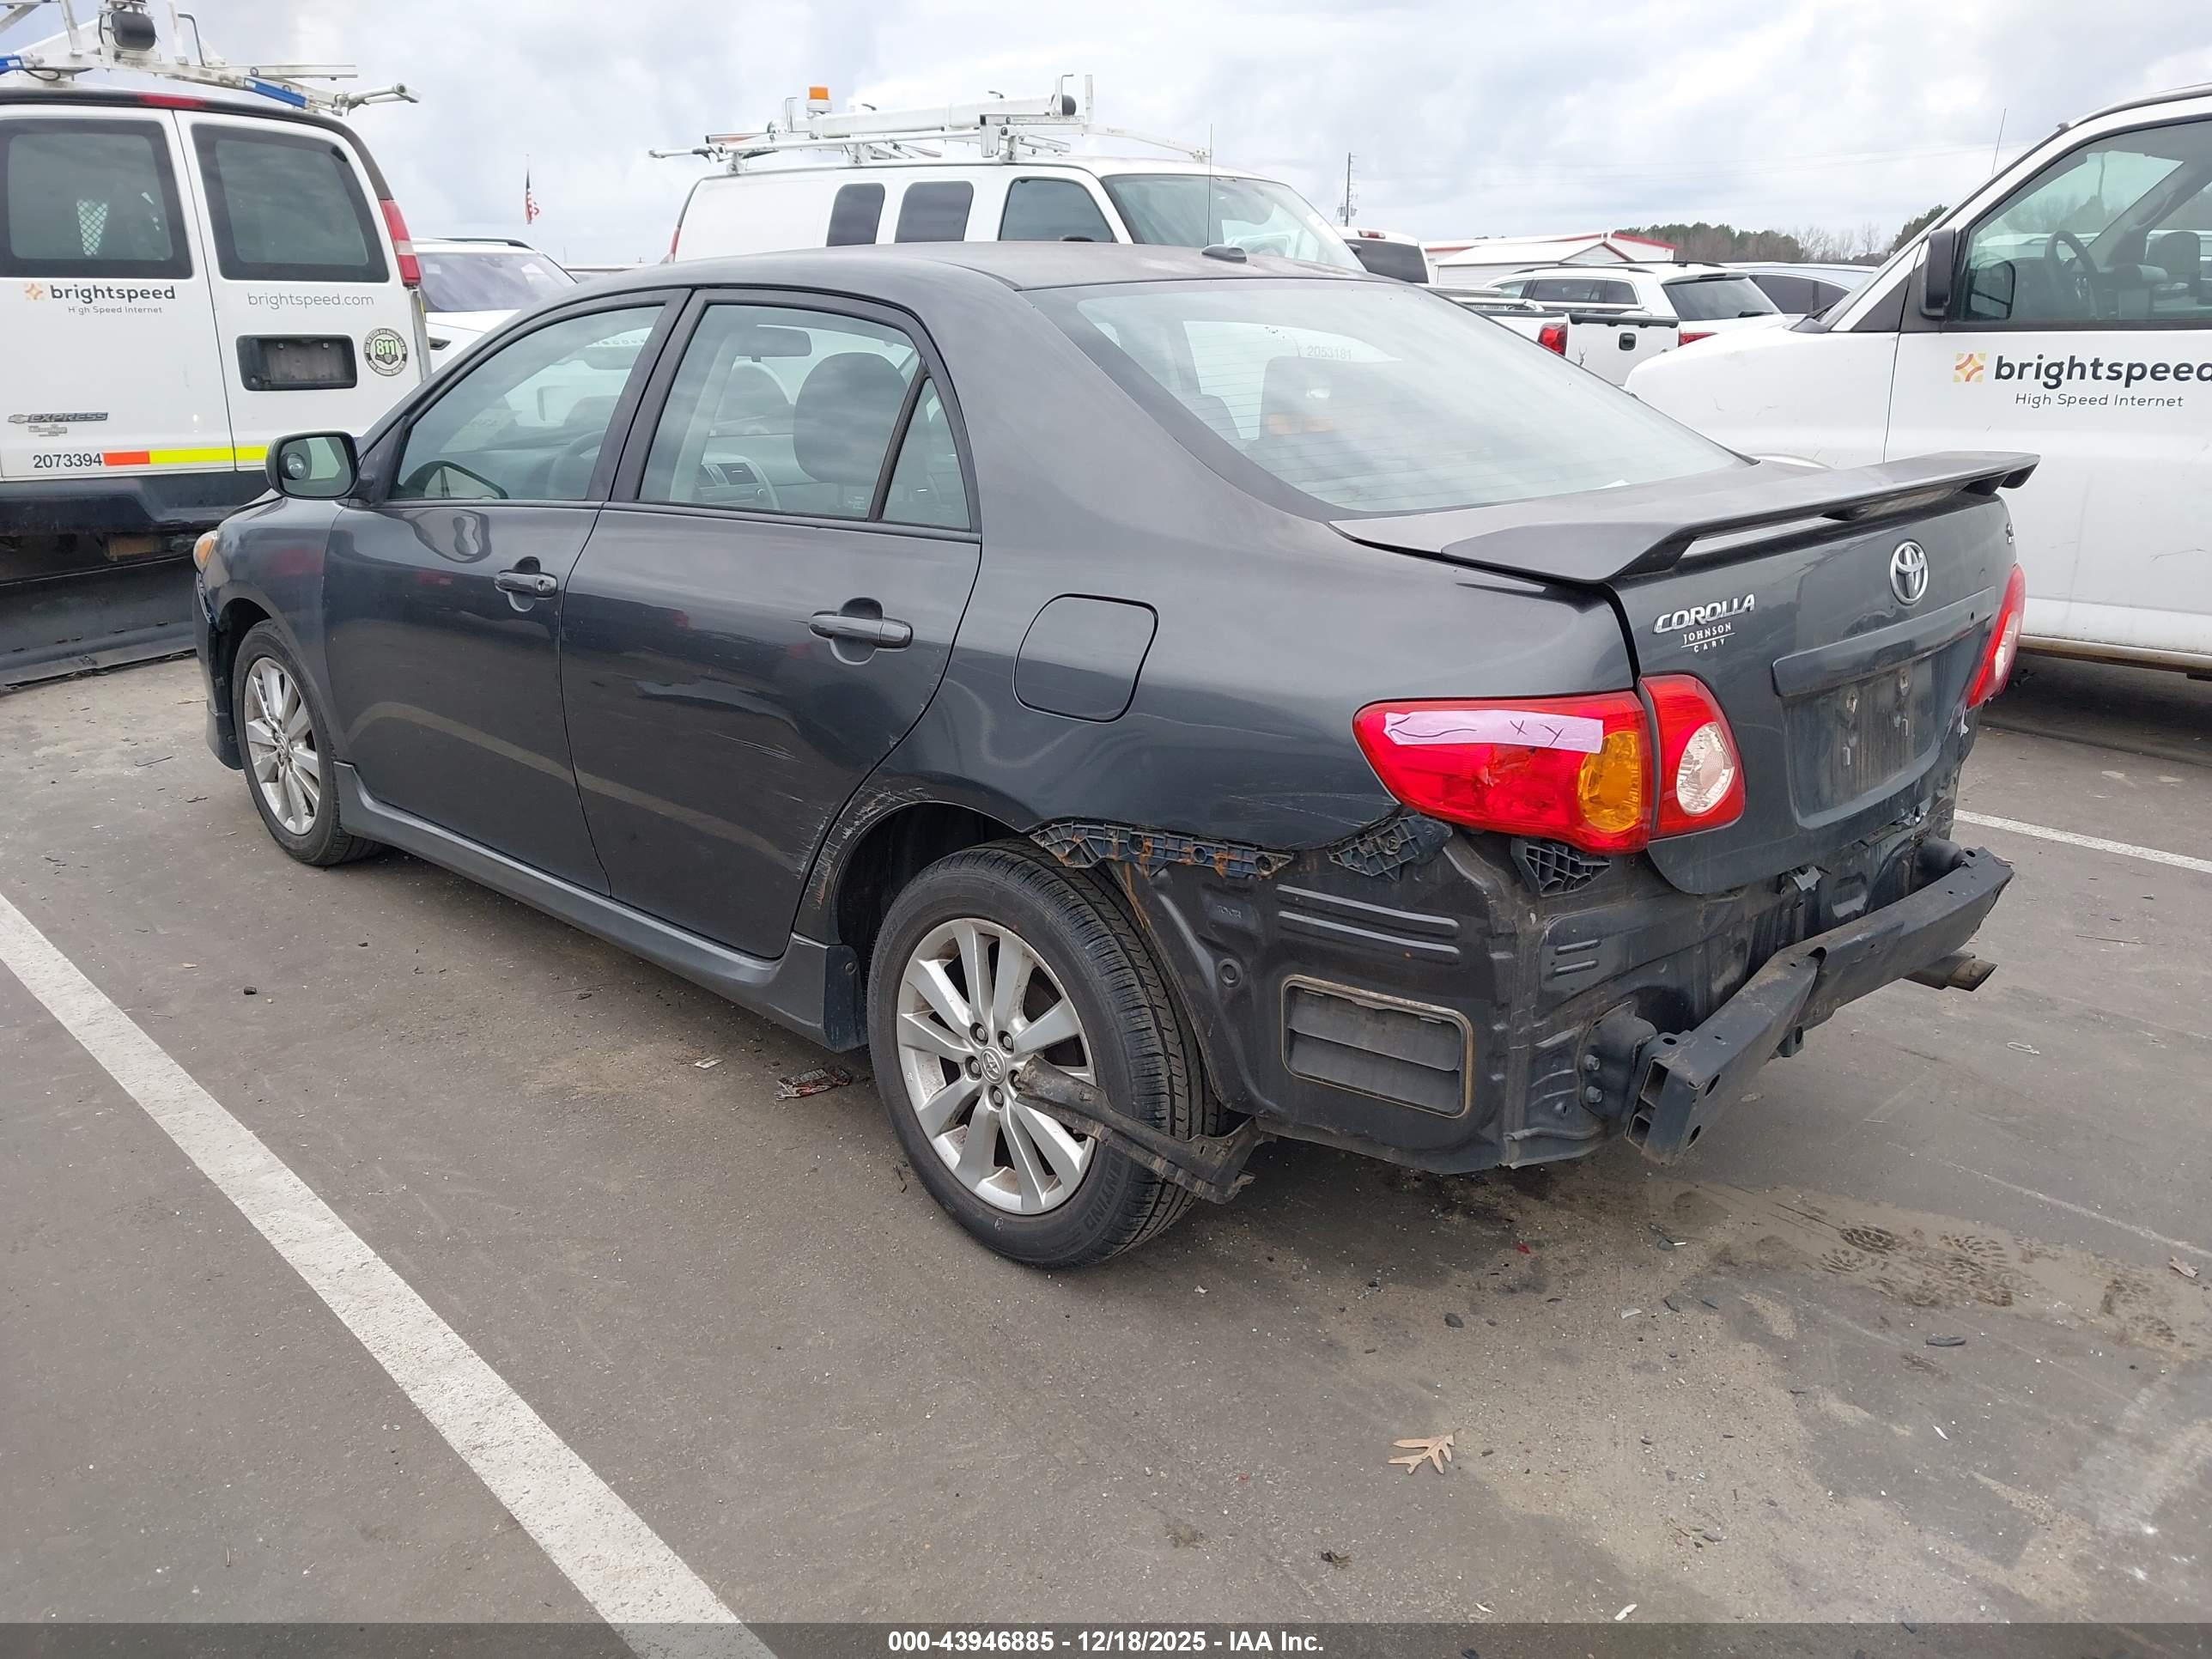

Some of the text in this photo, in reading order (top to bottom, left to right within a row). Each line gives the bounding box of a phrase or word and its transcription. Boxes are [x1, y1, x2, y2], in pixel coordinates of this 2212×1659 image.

[50, 284, 176, 304] brightspeed
[247, 292, 374, 310] brightspeed.com
[93, 306, 122, 315] Speed
[376, 339, 395, 355] 811
[2015, 392, 2185, 409] High Speed Internet
[28, 412, 108, 422] EXPRESS
[33, 453, 102, 468] 2073394
[1653, 593, 1755, 634] COROLLA
[1683, 622, 1732, 644] JOHNSON
[1693, 638, 1725, 653] CARY
